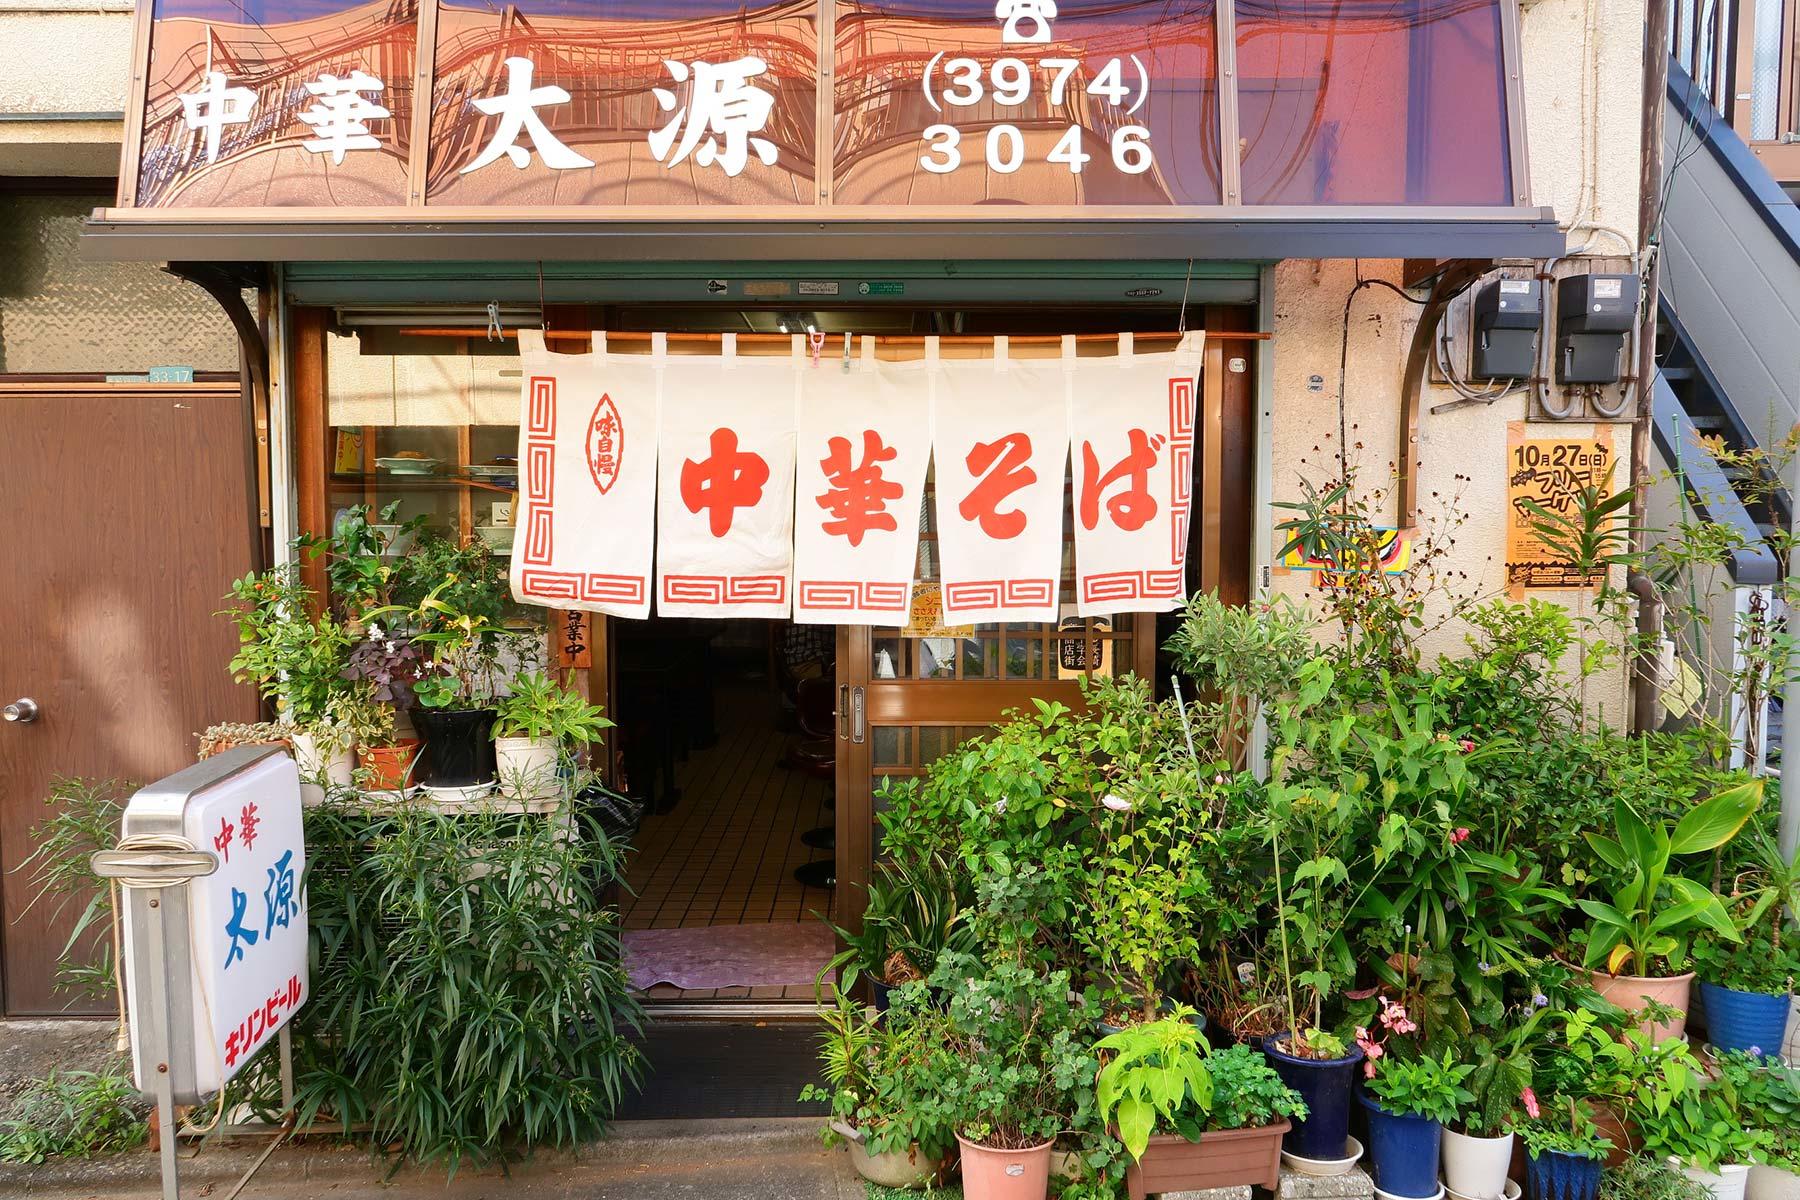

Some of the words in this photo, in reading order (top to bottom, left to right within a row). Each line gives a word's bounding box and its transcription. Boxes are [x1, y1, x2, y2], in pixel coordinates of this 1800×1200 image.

[921, 50, 1149, 115] (3974)
[919, 123, 1152, 175] 3046
[153, 369, 190, 383] 33-17
[594, 410, 618, 476] 味自慢
[679, 426, 1167, 548] 中華そば
[214, 802, 260, 864] 中華
[224, 849, 298, 971] 太源
[225, 974, 302, 1067] キリンビール
